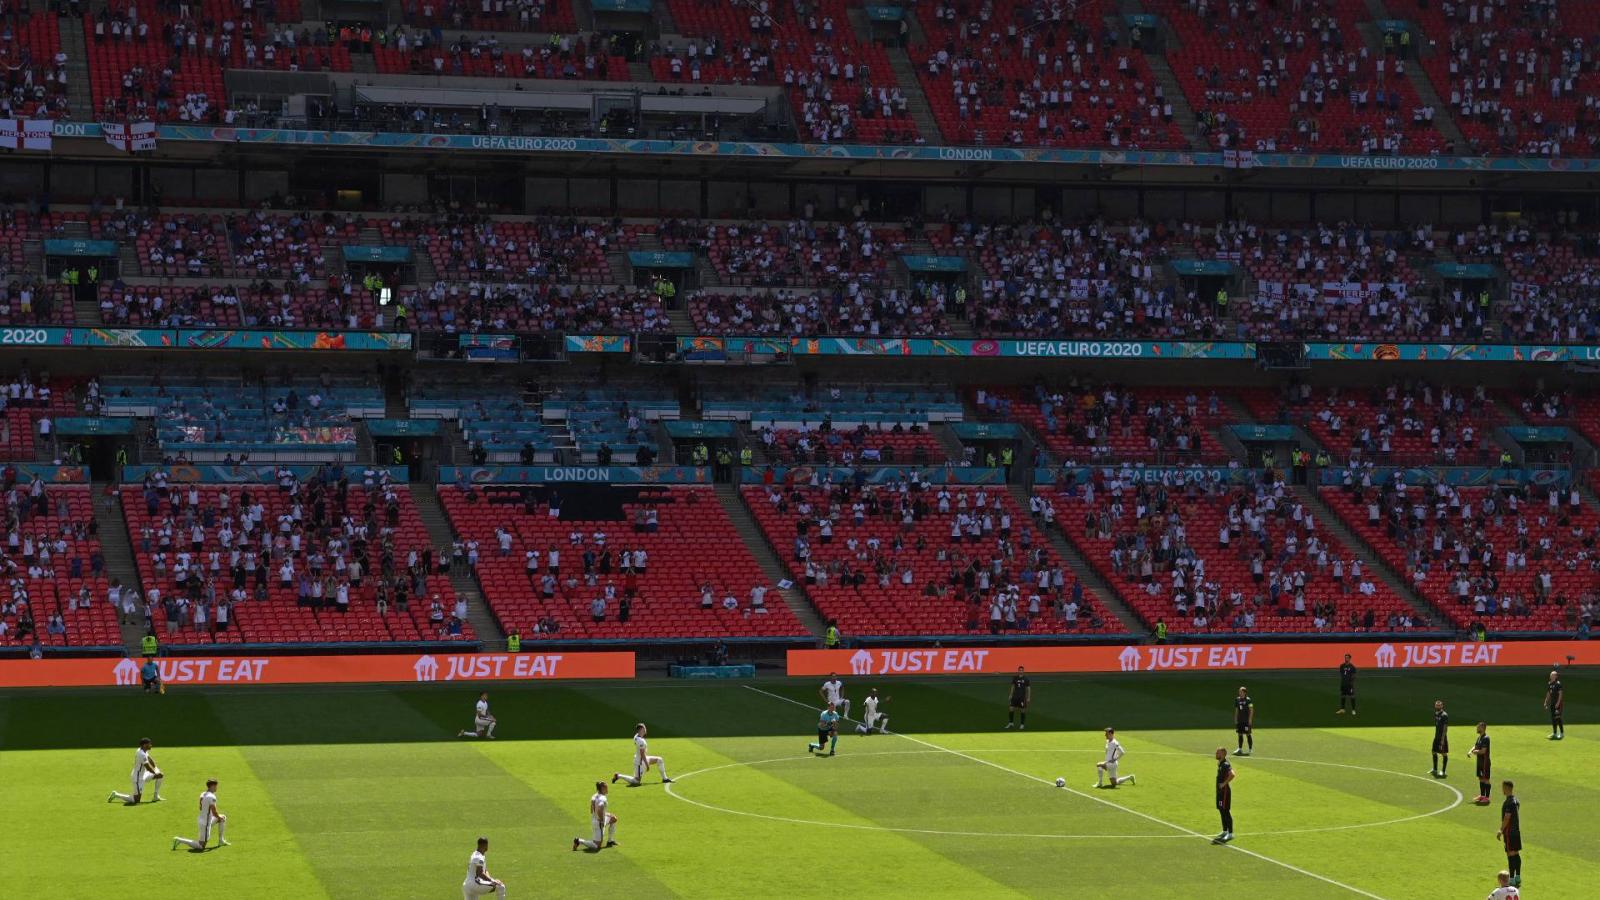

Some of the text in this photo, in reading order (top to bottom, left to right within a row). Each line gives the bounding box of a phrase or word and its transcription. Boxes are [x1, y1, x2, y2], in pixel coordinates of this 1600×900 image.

[472, 137, 577, 150] UEFA EURO 2020
[939, 147, 993, 160] LONDON
[1341, 157, 1438, 169] UEFA EURO 2020
[2, 329, 47, 344] 2020
[1016, 341, 1142, 357] UEFA EURO 2020
[544, 468, 609, 481] LONDON
[879, 650, 989, 675] JUST EAT
[1147, 646, 1252, 671] JUST EAT
[1402, 644, 1503, 668] JUST EAT
[217, 659, 270, 681] EAT
[445, 655, 563, 681] JUST EAT
